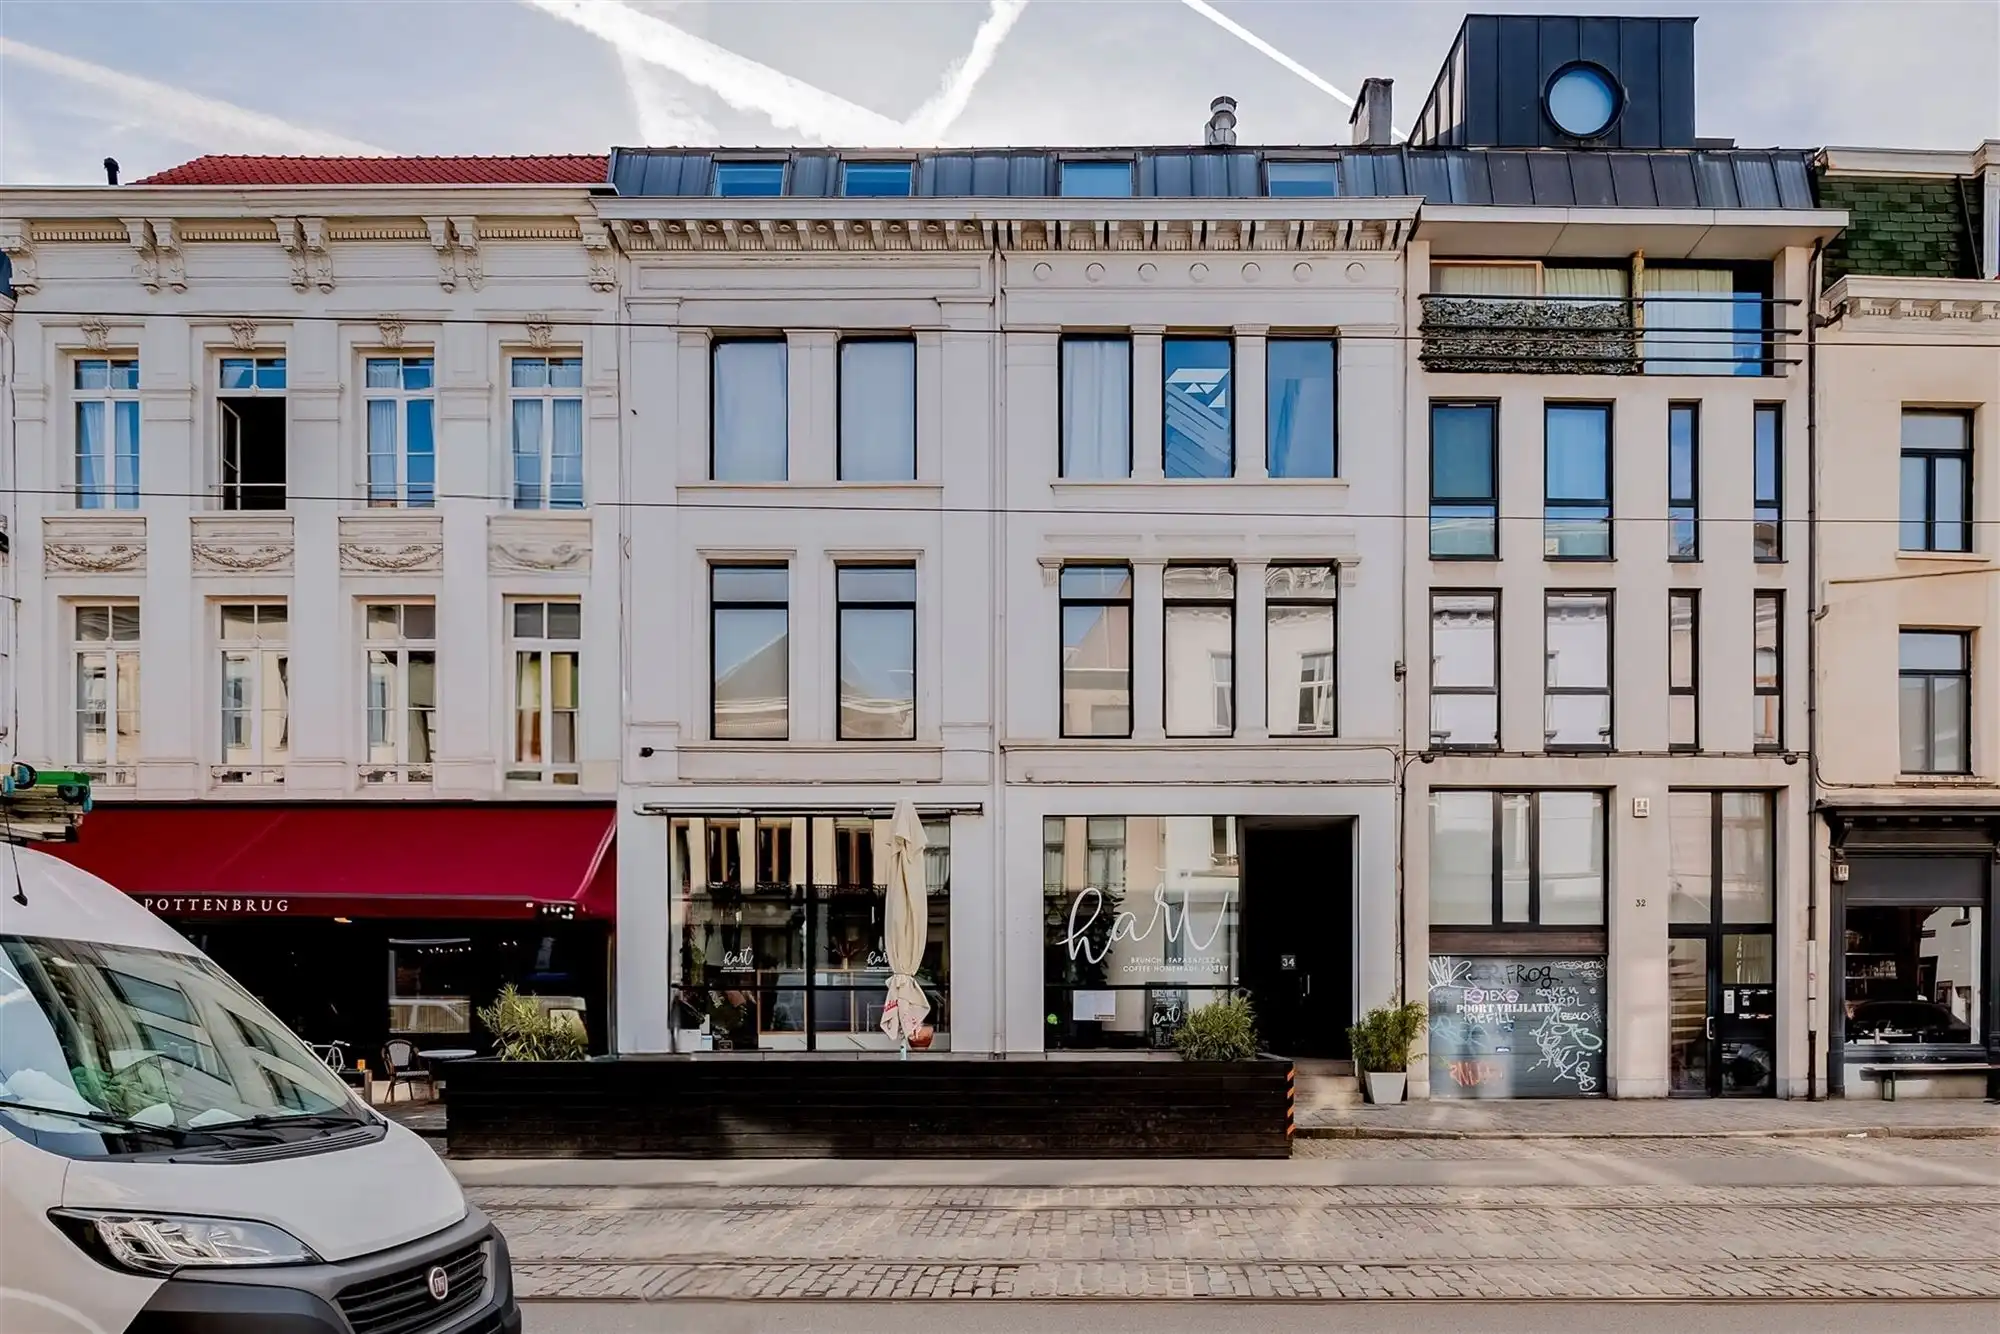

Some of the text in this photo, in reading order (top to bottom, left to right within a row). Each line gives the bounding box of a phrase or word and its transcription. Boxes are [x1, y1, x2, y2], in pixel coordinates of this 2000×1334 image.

[143, 898, 290, 913] POTTENBRUG
[1635, 899, 1647, 908] 32
[1056, 866, 1229, 964] hart
[723, 946, 754, 966] hart
[867, 951, 888, 966] har
[1281, 958, 1295, 967] 34
[1122, 965, 1151, 973] COFFEE
[1456, 1003, 1491, 1013] POORT
